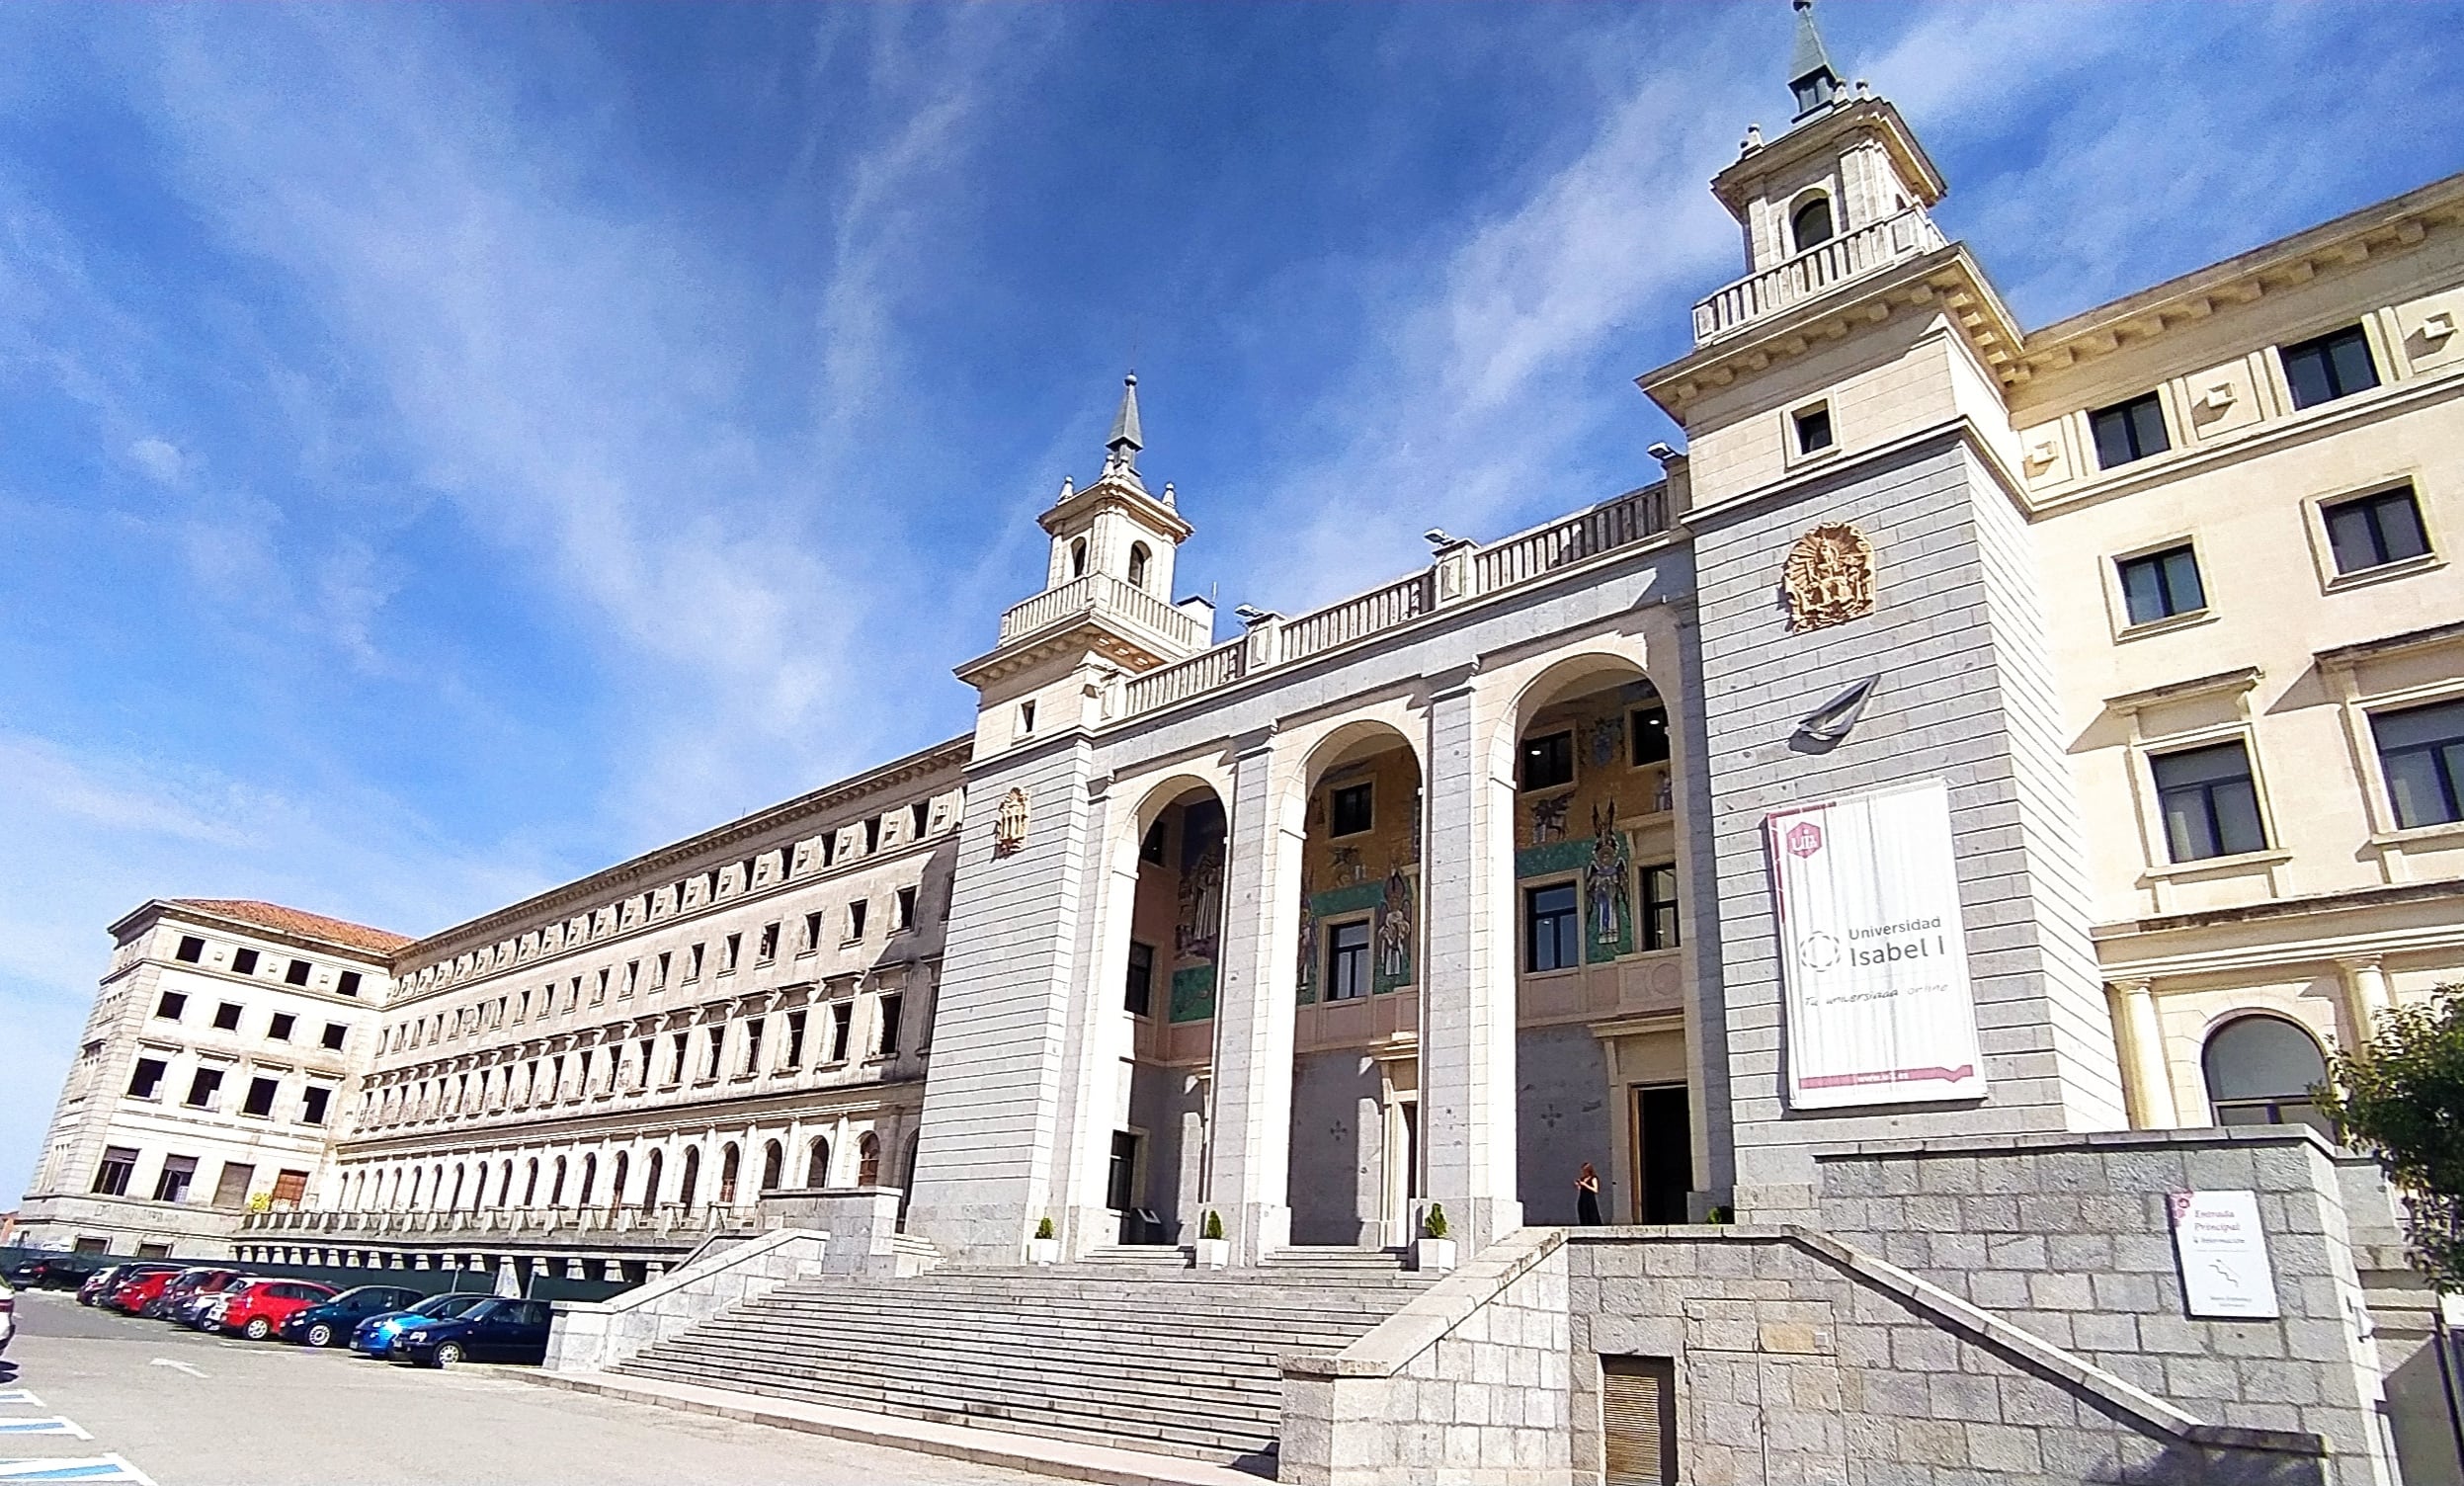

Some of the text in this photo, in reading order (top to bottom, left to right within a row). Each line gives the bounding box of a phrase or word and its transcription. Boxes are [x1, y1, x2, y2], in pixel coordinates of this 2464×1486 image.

[1848, 916, 1941, 940] Universidad
[1850, 935, 1945, 966] Isabel I
